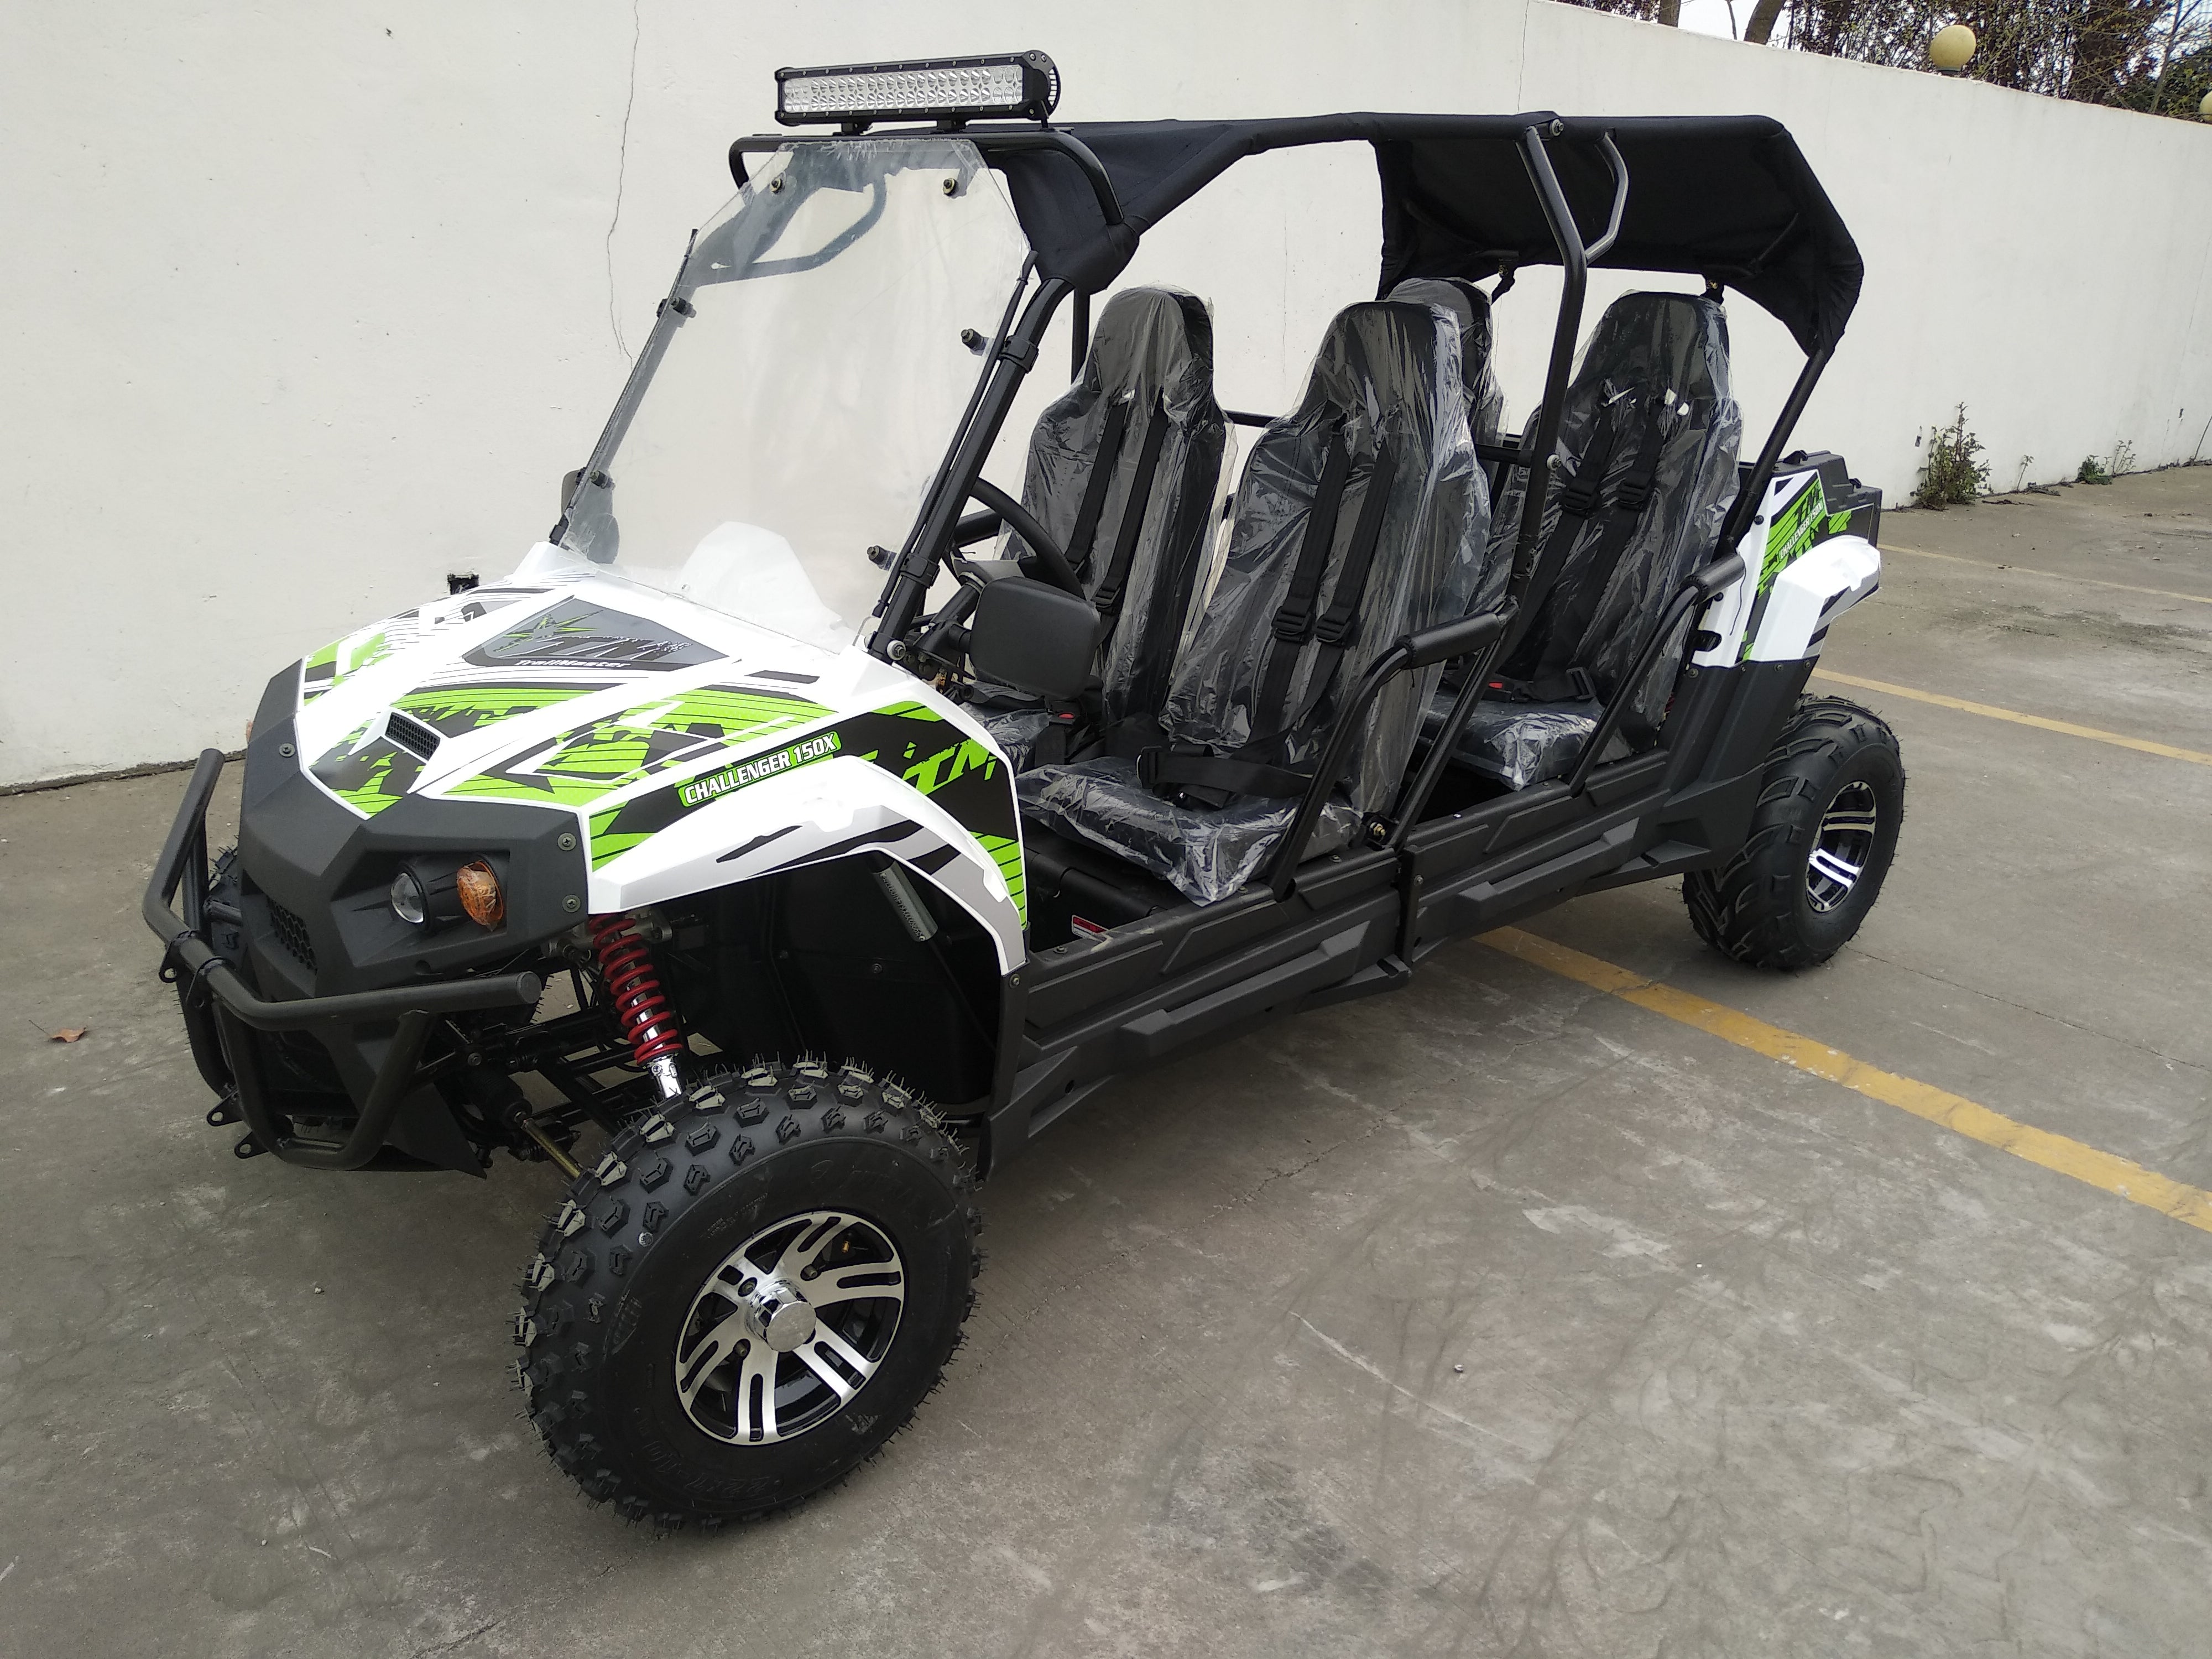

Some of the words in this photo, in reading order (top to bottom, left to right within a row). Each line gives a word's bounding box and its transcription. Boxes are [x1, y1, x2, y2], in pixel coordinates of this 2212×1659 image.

[1781, 517, 1809, 560] CHALLENGER
[514, 659, 632, 669] TrailMaster
[685, 750, 791, 805] CHALLENGER
[794, 732, 838, 764] 150X
